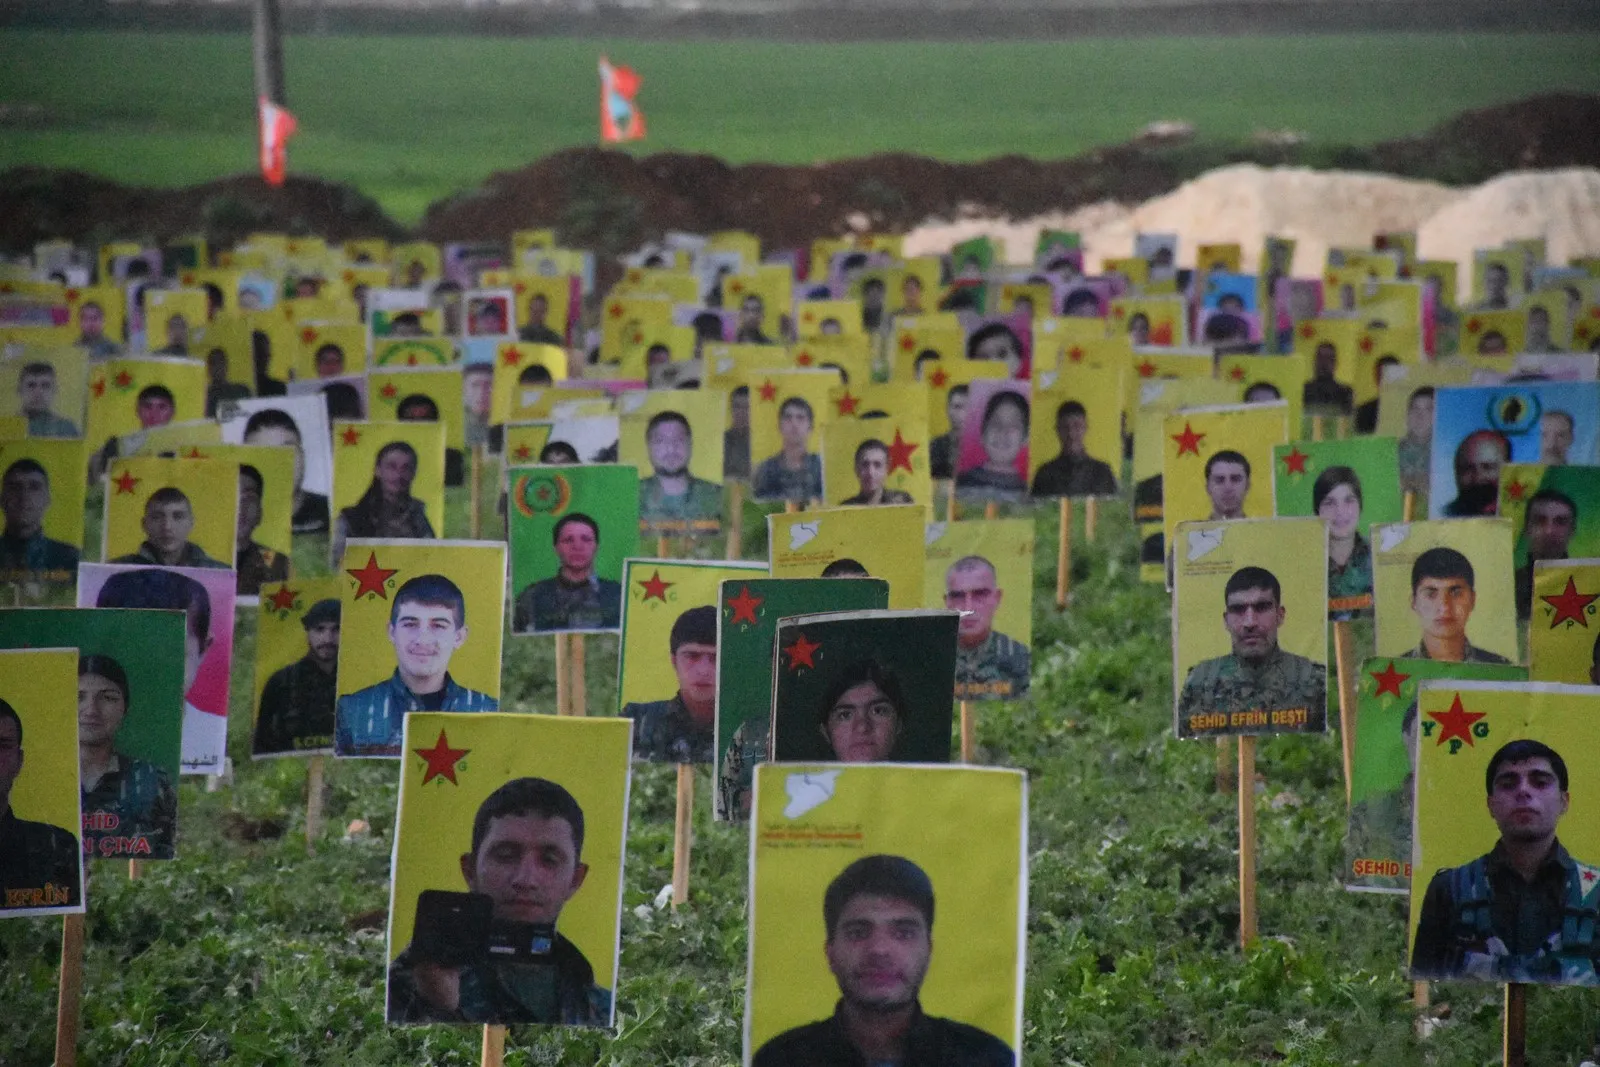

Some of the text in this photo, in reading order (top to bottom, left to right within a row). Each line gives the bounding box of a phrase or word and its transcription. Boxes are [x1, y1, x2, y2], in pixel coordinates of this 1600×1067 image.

[1421, 721, 1489, 755] Y P G
